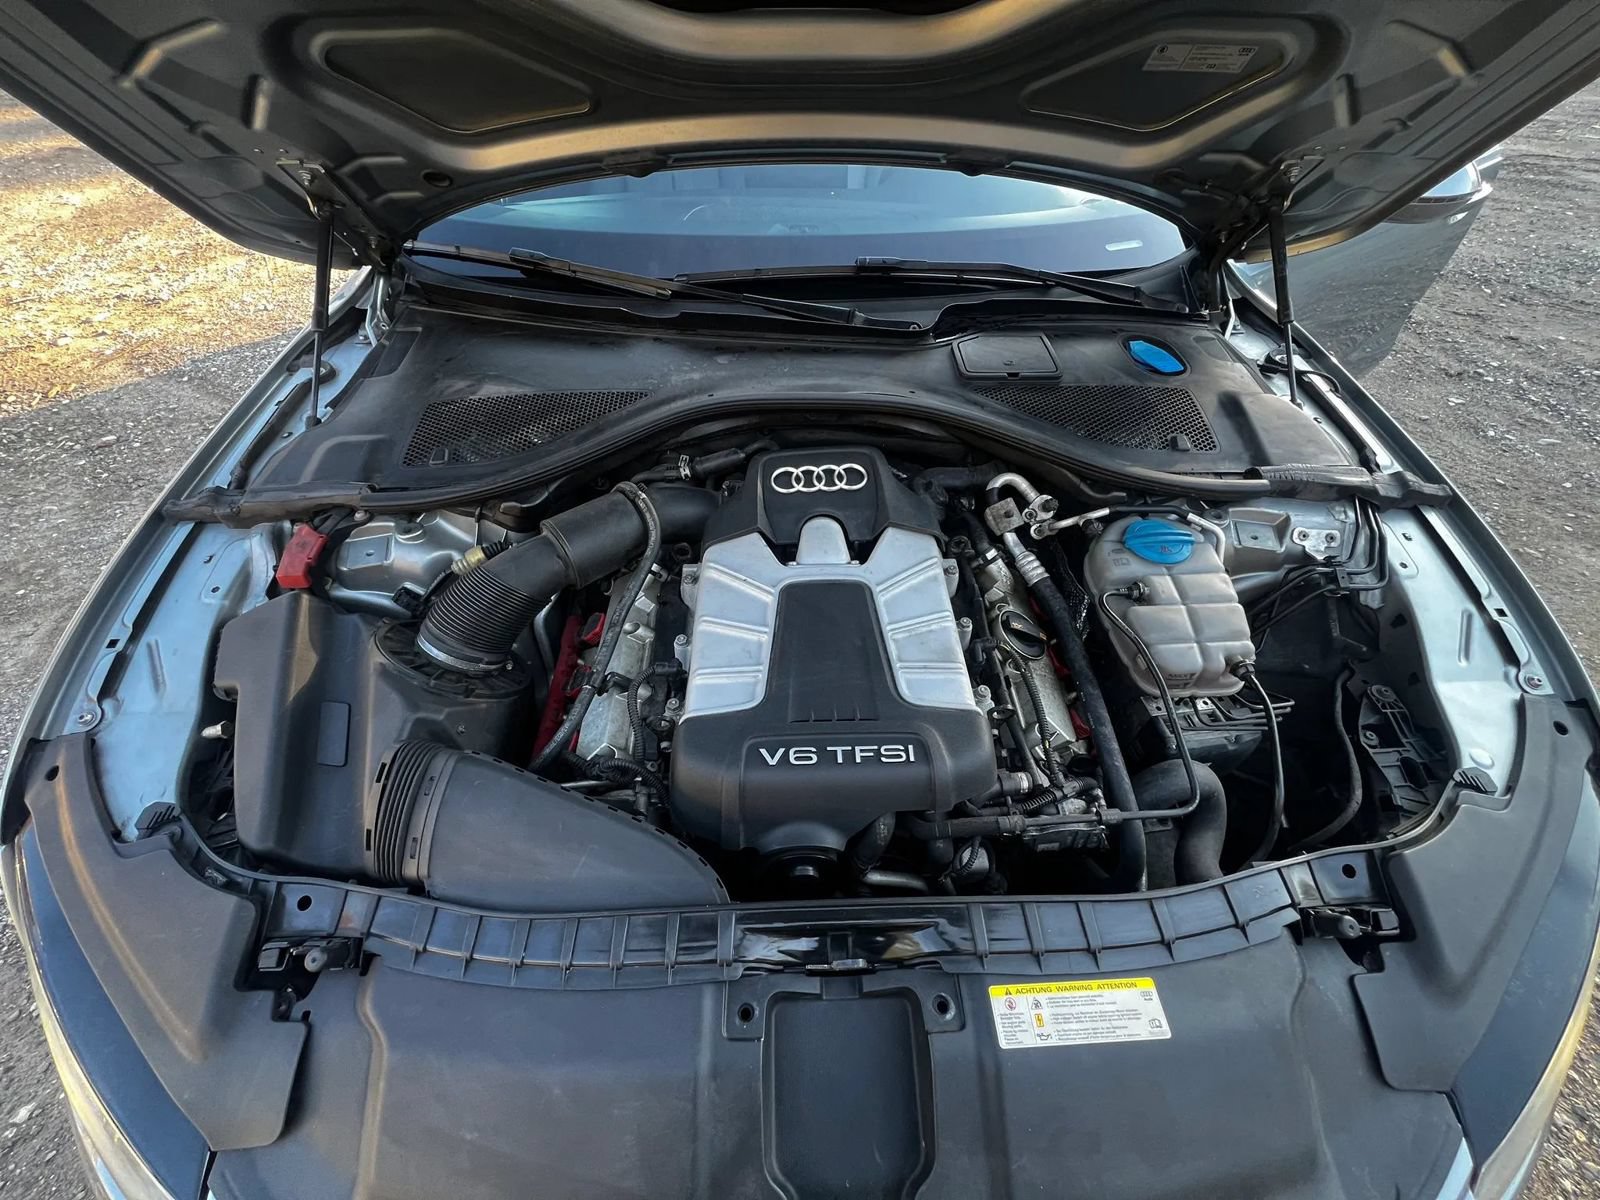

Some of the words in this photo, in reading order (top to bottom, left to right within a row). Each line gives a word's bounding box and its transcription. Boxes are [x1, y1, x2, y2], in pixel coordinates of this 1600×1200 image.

[759, 747, 818, 765] V6
[827, 745, 916, 764] TFSI
[1015, 986, 1053, 995] ACHTUNG
[1055, 984, 1093, 992] WARNING
[1096, 982, 1138, 990] ATTENTION
